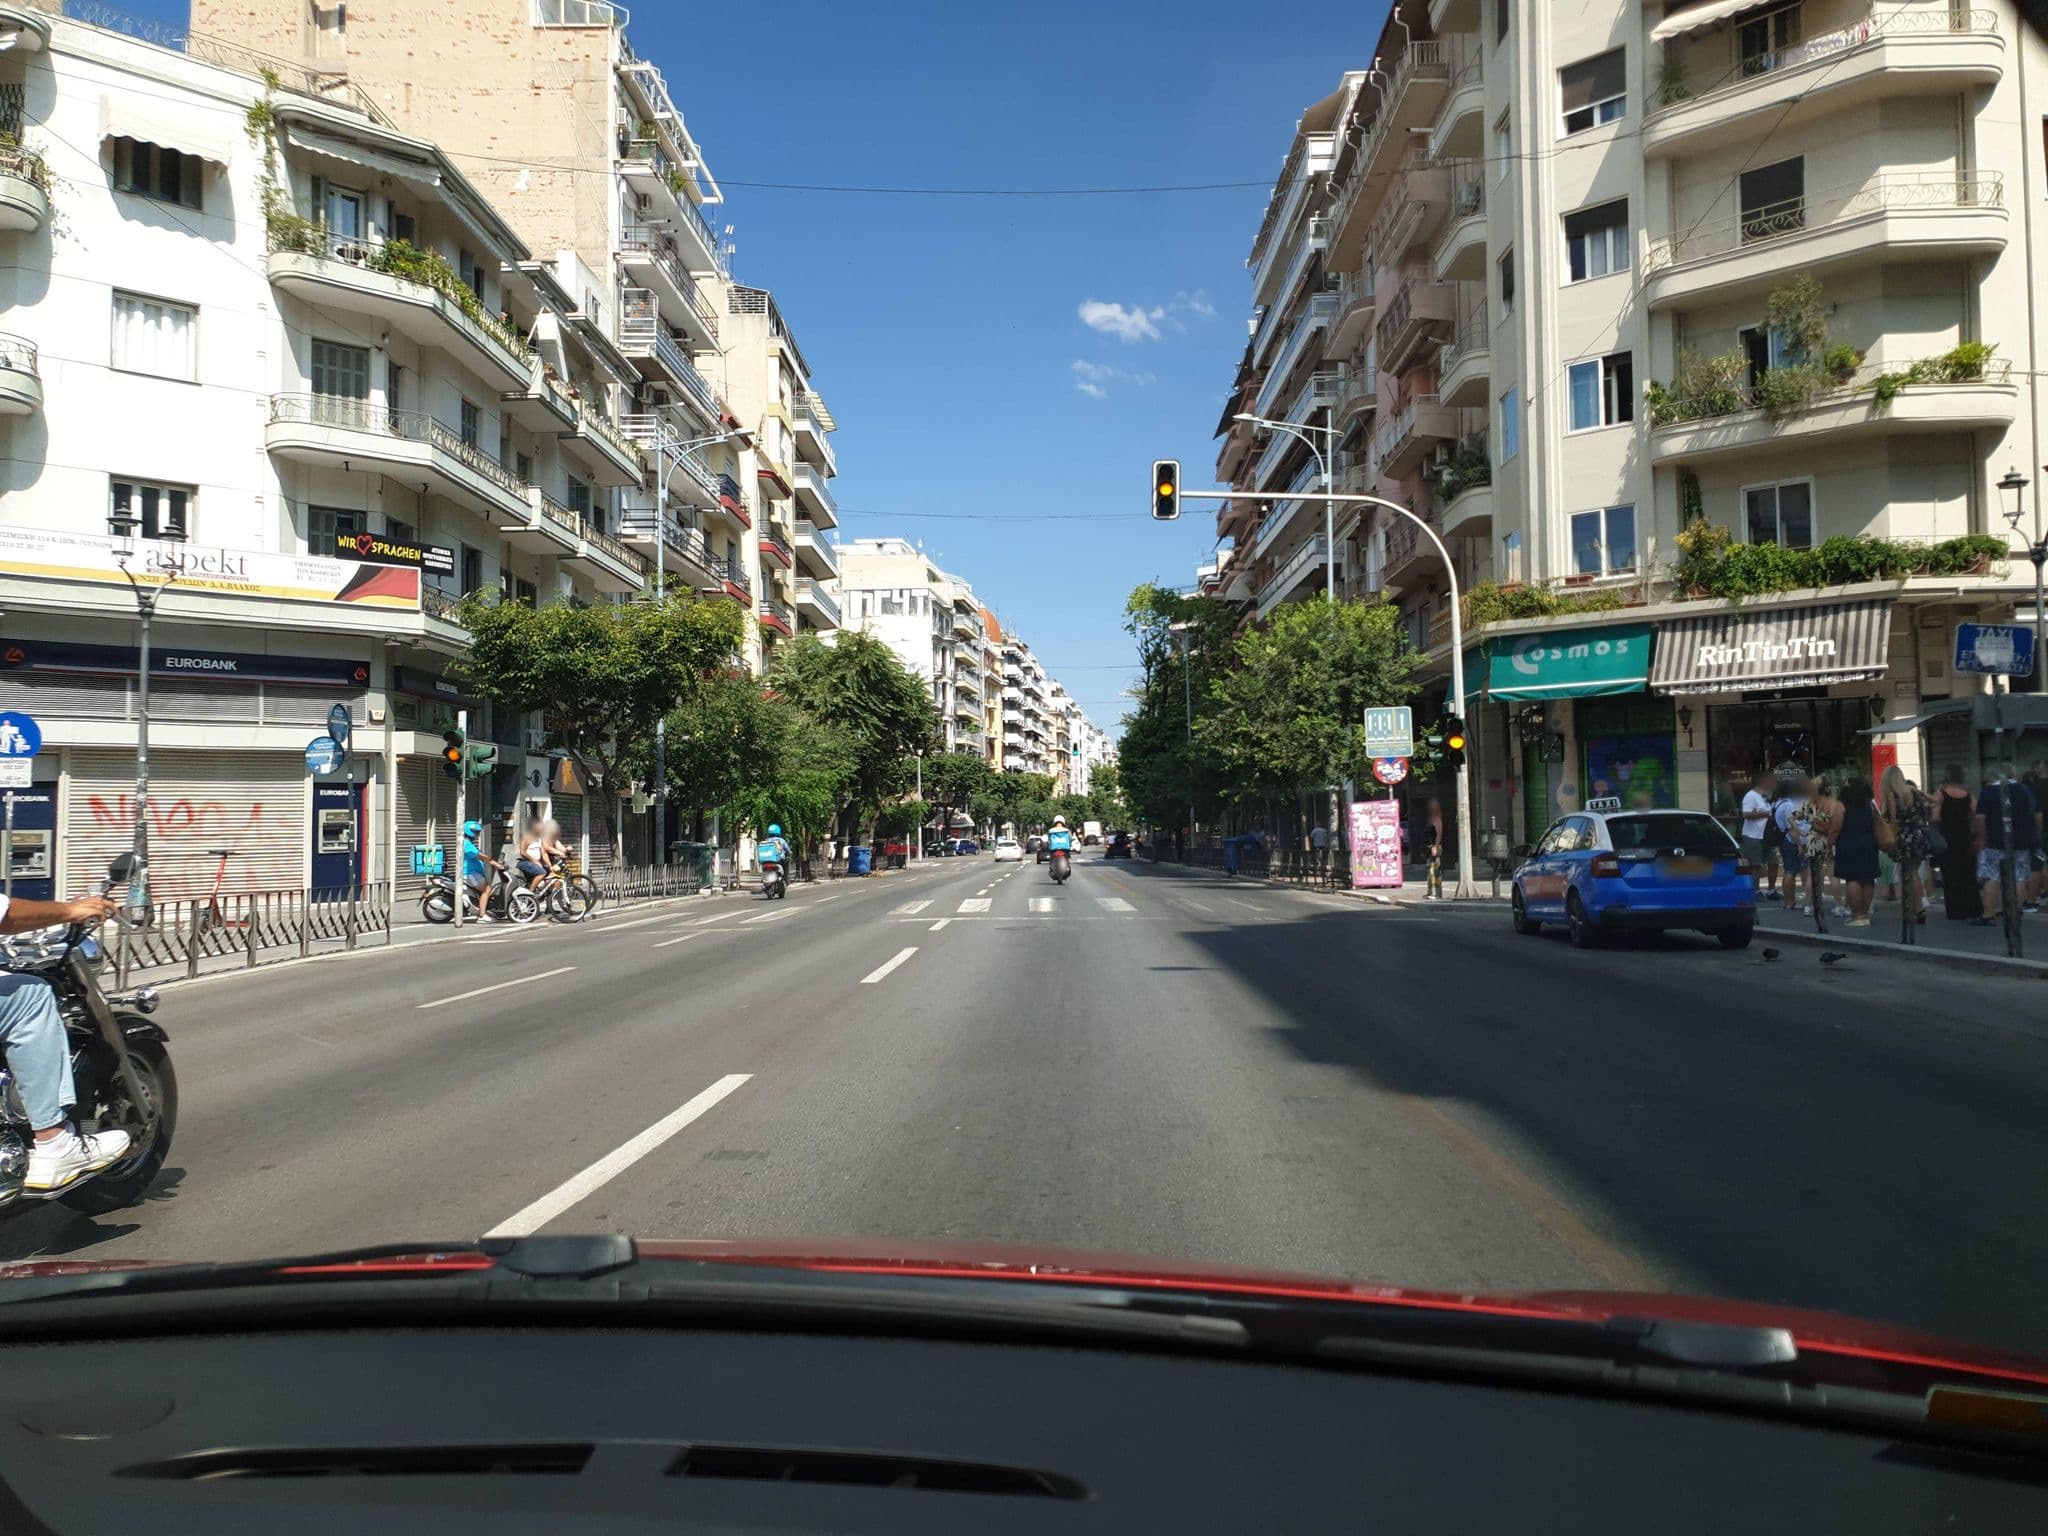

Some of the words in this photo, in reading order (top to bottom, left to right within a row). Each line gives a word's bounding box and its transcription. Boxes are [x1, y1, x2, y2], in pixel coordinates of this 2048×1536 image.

[338, 535, 357, 550] WIR
[371, 541, 422, 561] SPRACHEN
[146, 548, 248, 576] aspekt
[166, 657, 237, 671] EUROBANK
[1511, 635, 1628, 675] Cosmos
[1697, 636, 1836, 666] RinTinTin
[1591, 800, 1618, 810] TAXI
